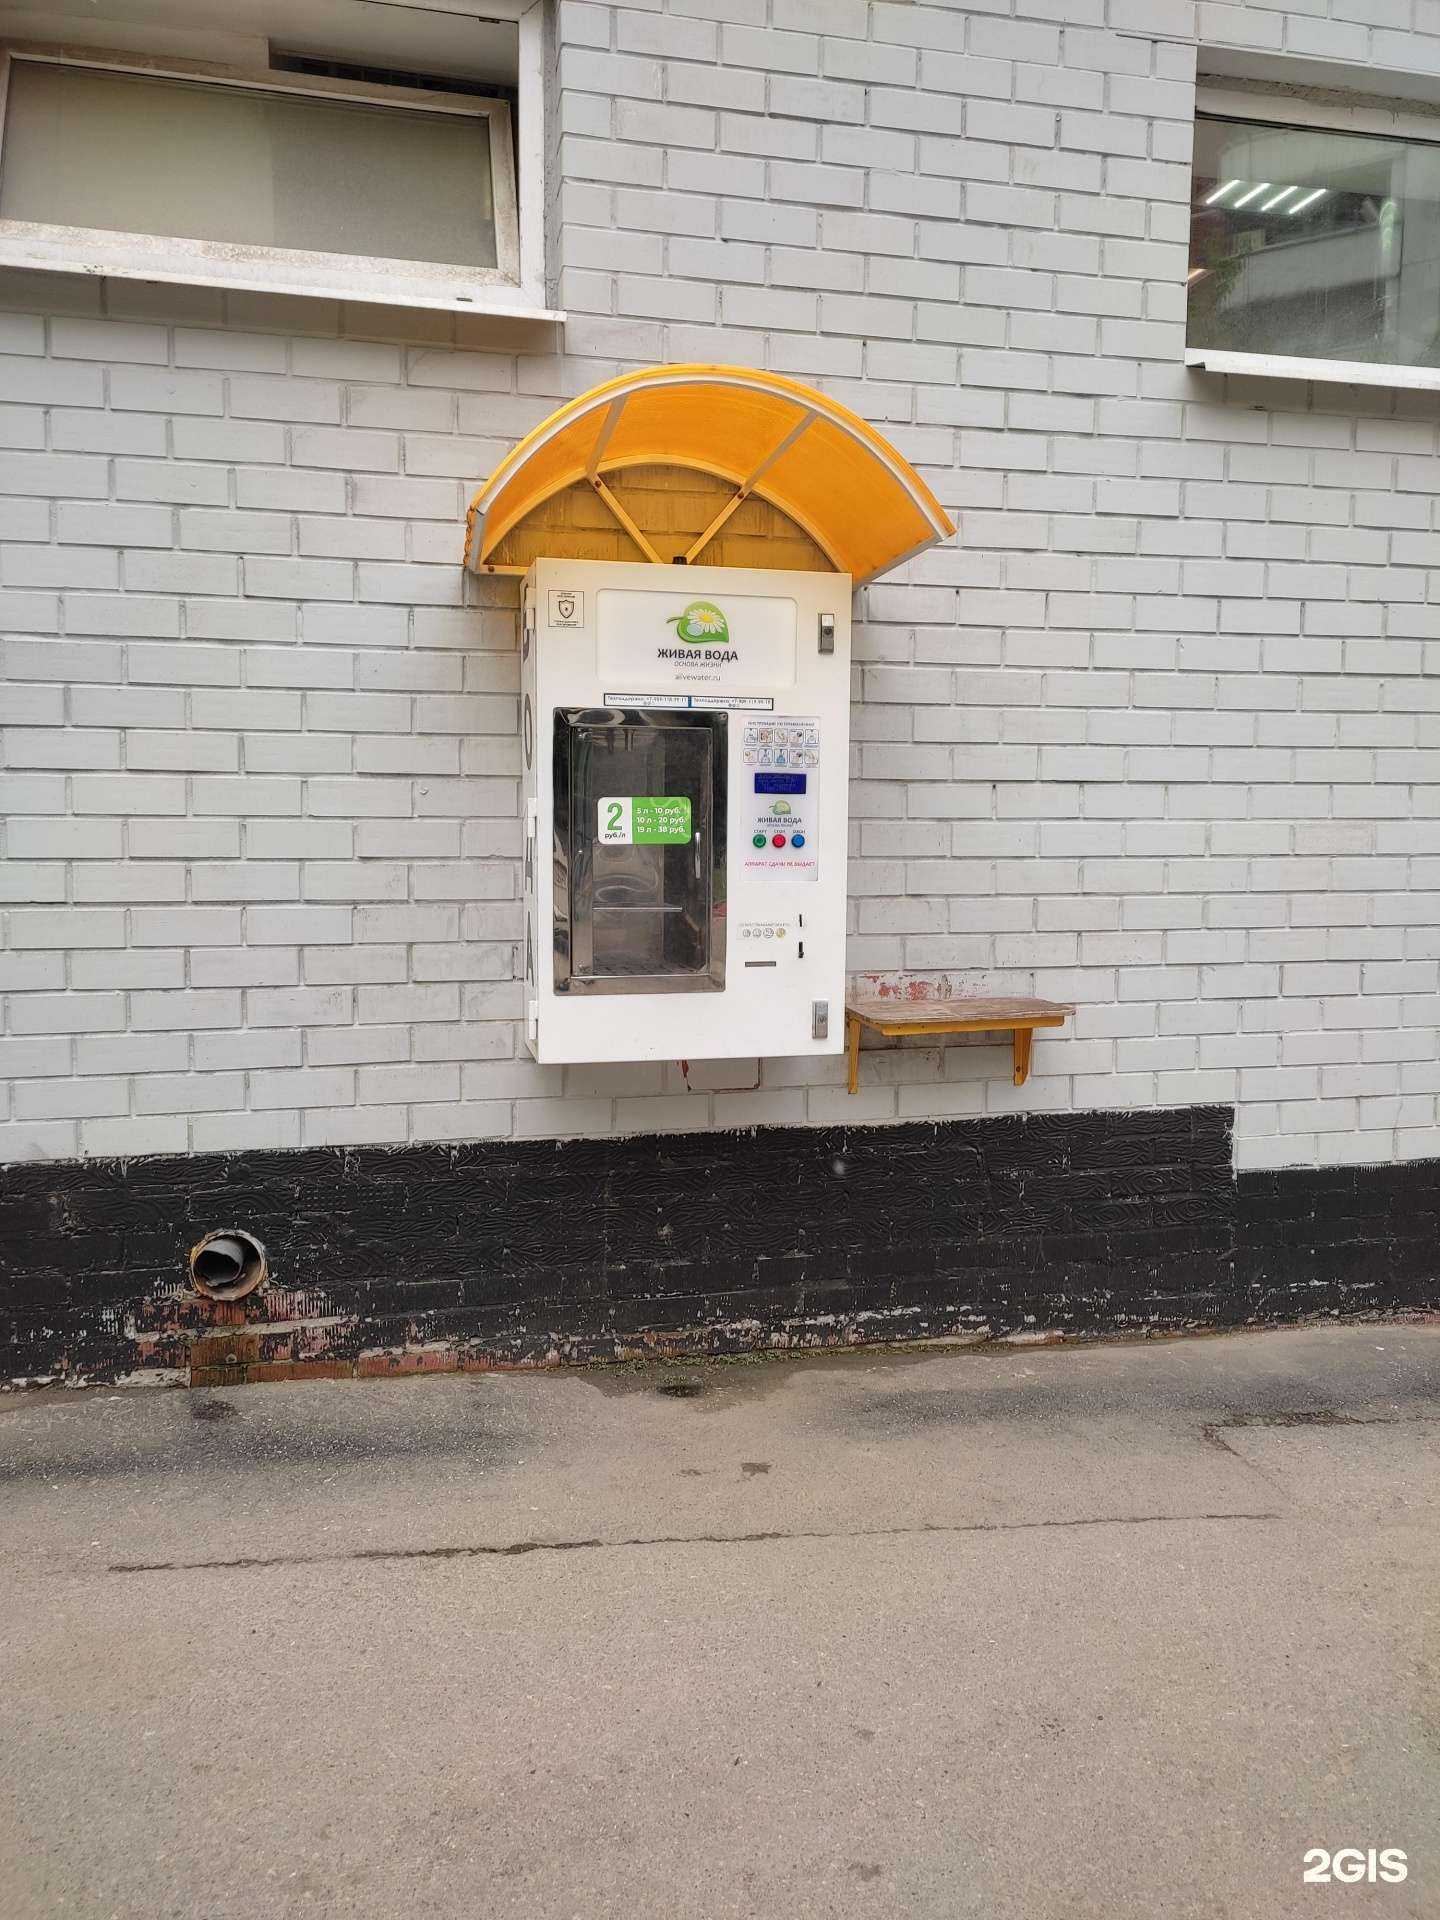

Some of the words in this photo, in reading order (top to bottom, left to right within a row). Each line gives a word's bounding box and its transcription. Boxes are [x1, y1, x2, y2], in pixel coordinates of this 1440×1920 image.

[657, 648, 702, 659] ЖИВАЯ
[704, 650, 739, 663] ВОДА
[664, 807, 681, 816] руб.
[607, 802, 623, 831] 2
[669, 817, 686, 825] руб.
[783, 817, 802, 825] ВОДА
[669, 826, 686, 834] руб.
